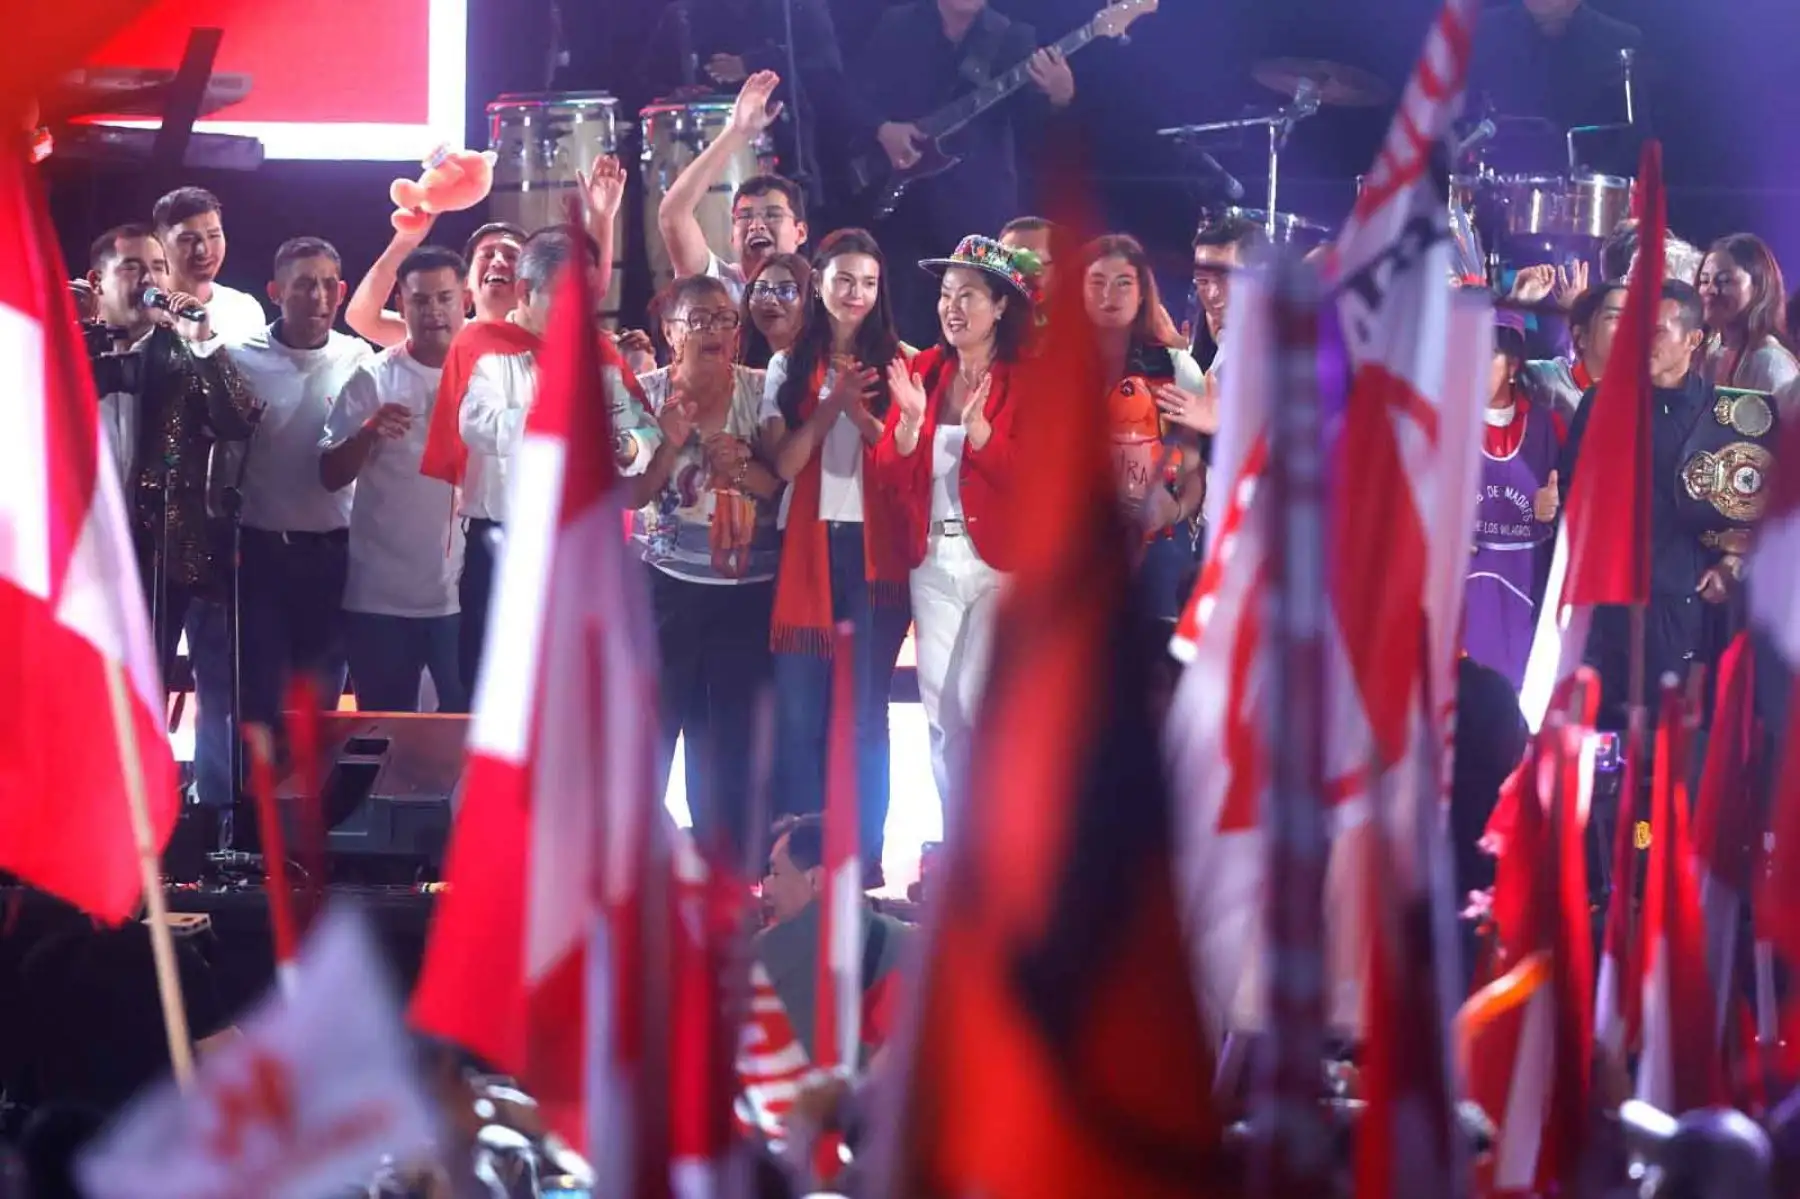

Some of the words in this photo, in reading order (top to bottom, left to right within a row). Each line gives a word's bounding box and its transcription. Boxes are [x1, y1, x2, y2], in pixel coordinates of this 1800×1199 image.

[1486, 485, 1500, 498] DE
[1504, 486, 1534, 523] MADRES
[1484, 521, 1498, 534] LOS
